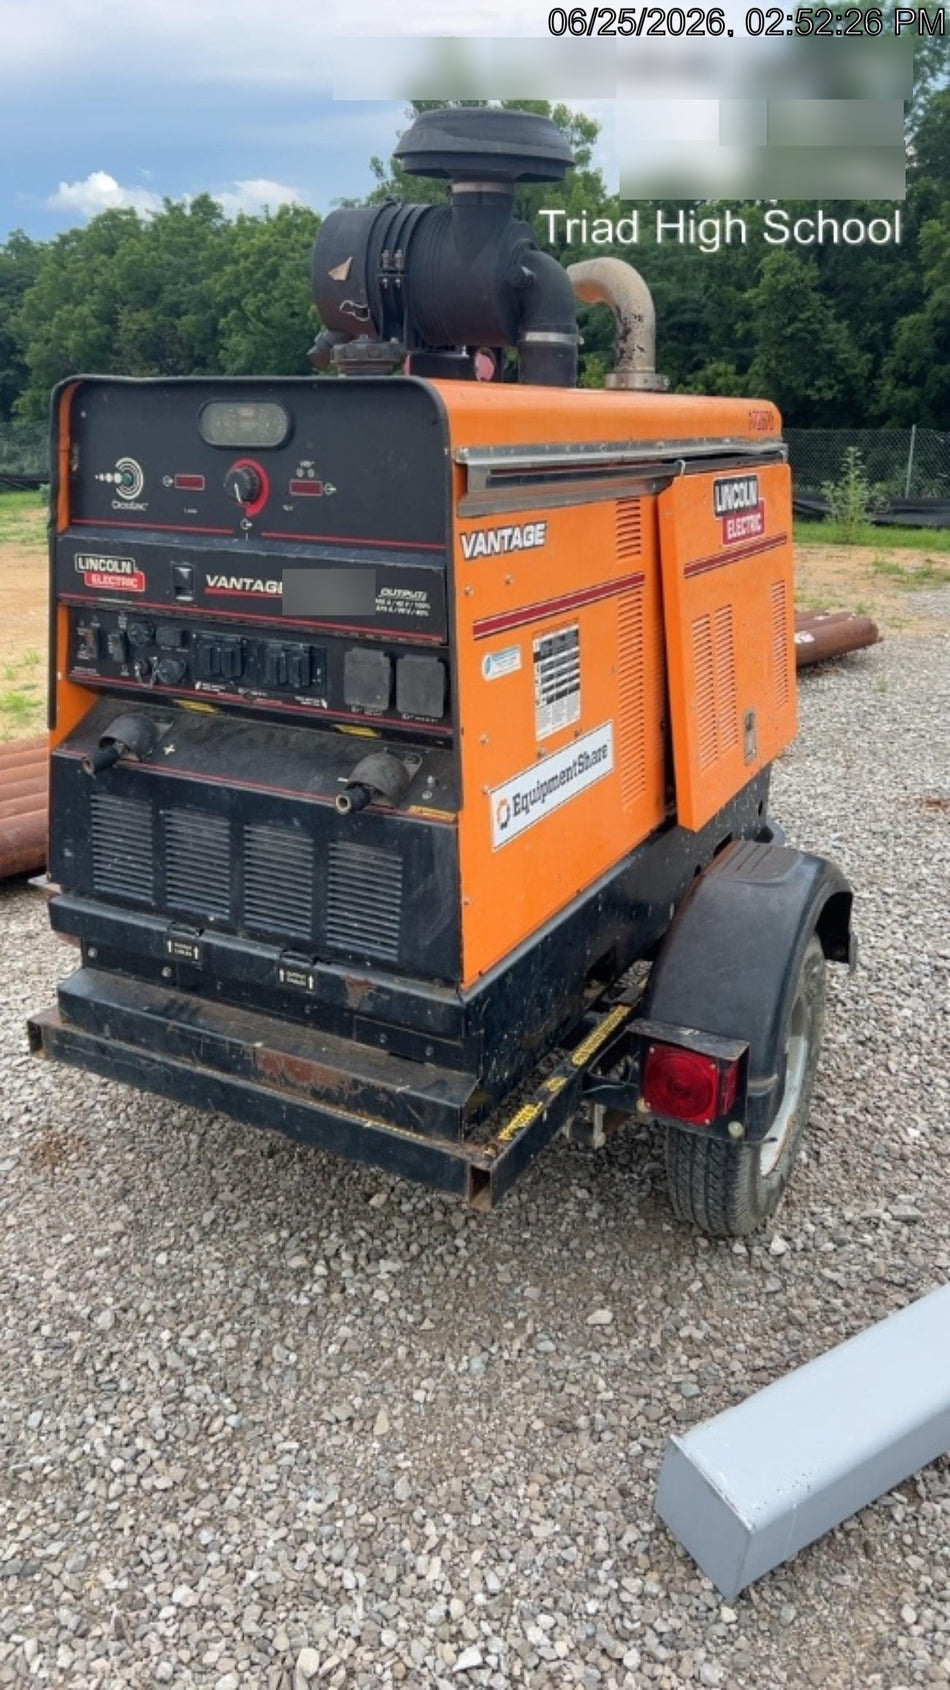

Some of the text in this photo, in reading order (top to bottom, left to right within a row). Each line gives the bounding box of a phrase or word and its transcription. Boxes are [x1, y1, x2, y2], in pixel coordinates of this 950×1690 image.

[714, 480, 758, 512] LINCOLN
[460, 521, 548, 560] VANTAGE
[727, 512, 763, 540] ELECTRIC
[78, 557, 132, 574] LINCOLN
[91, 573, 139, 589] ELECTRIC
[512, 744, 608, 817] EquipmentShare
